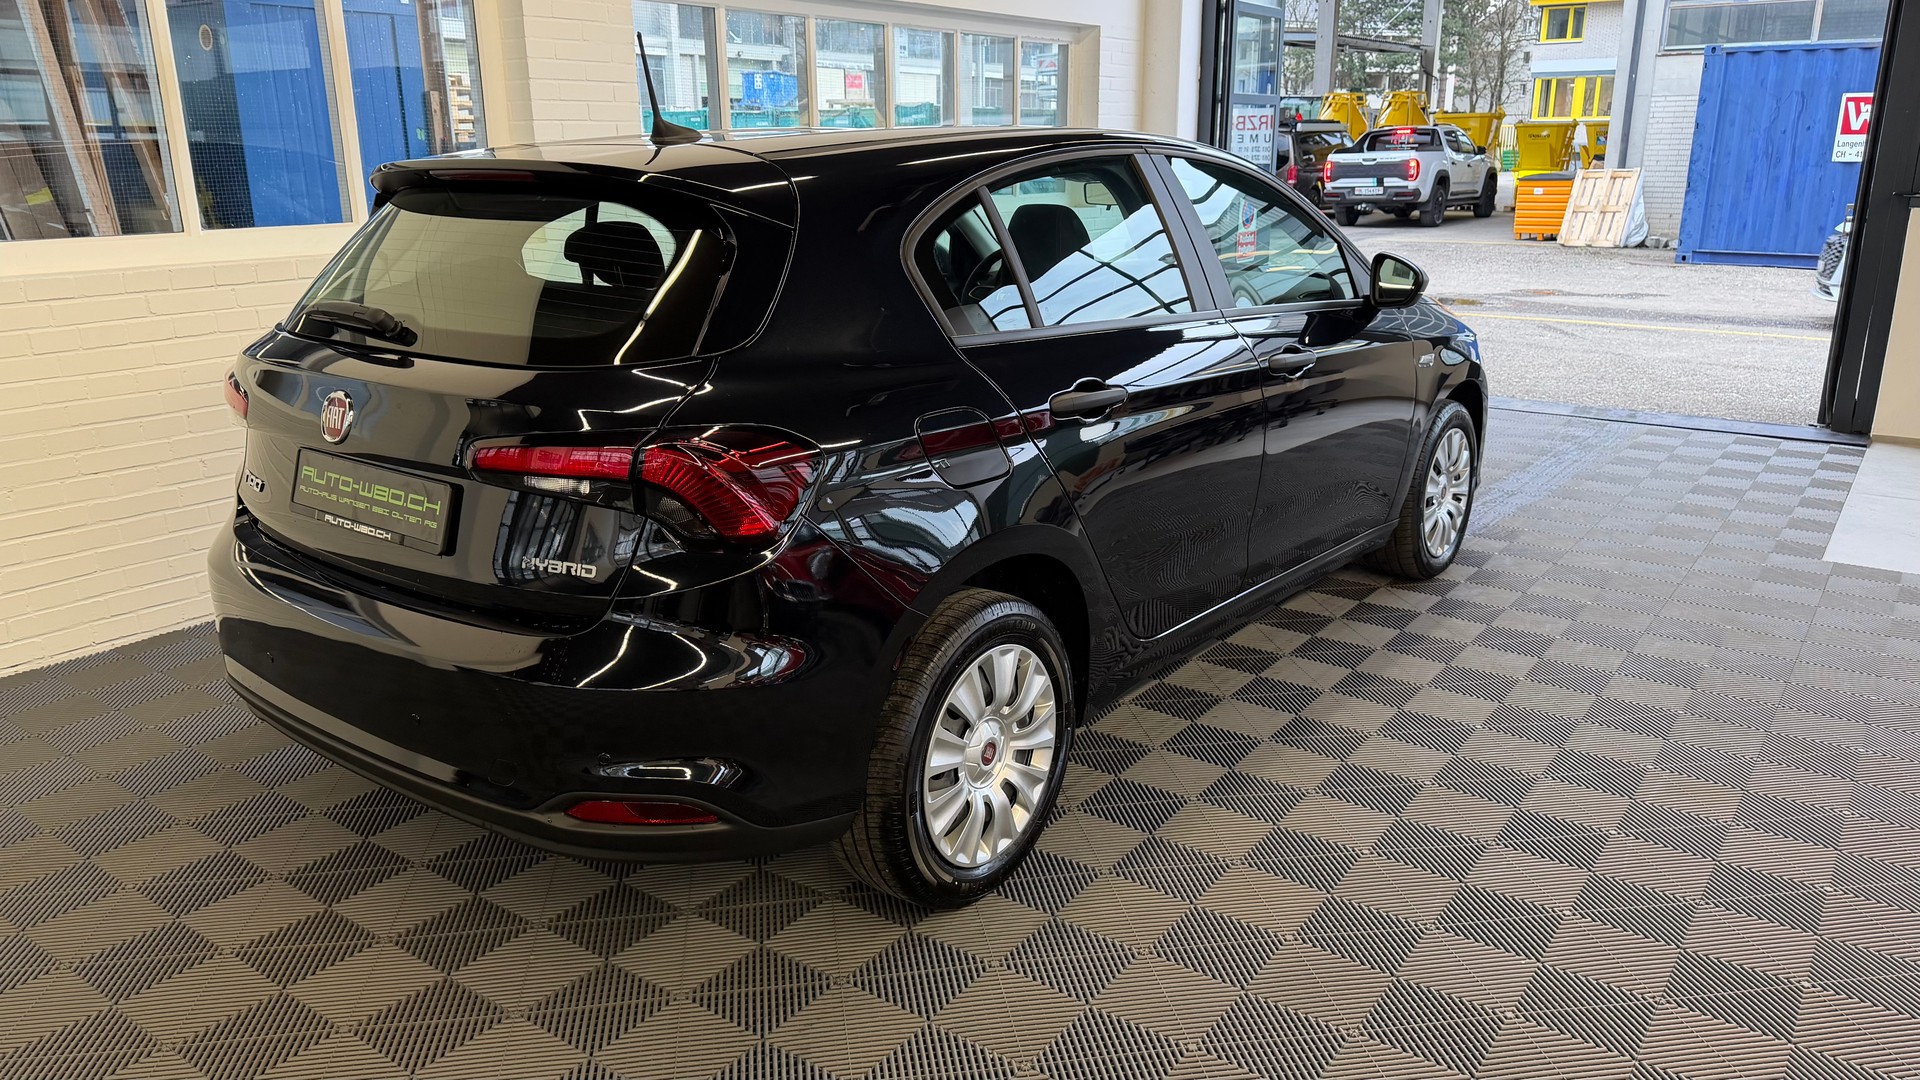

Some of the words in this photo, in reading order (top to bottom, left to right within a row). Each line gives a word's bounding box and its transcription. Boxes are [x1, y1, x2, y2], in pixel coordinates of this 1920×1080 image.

[1835, 150, 1846, 159] CH
[326, 405, 345, 430] FIAT
[299, 484, 338, 502] AUTOHAUS
[338, 496, 370, 512] WANGEN
[391, 510, 422, 524] OLTEN
[521, 556, 597, 579] HYBRID
